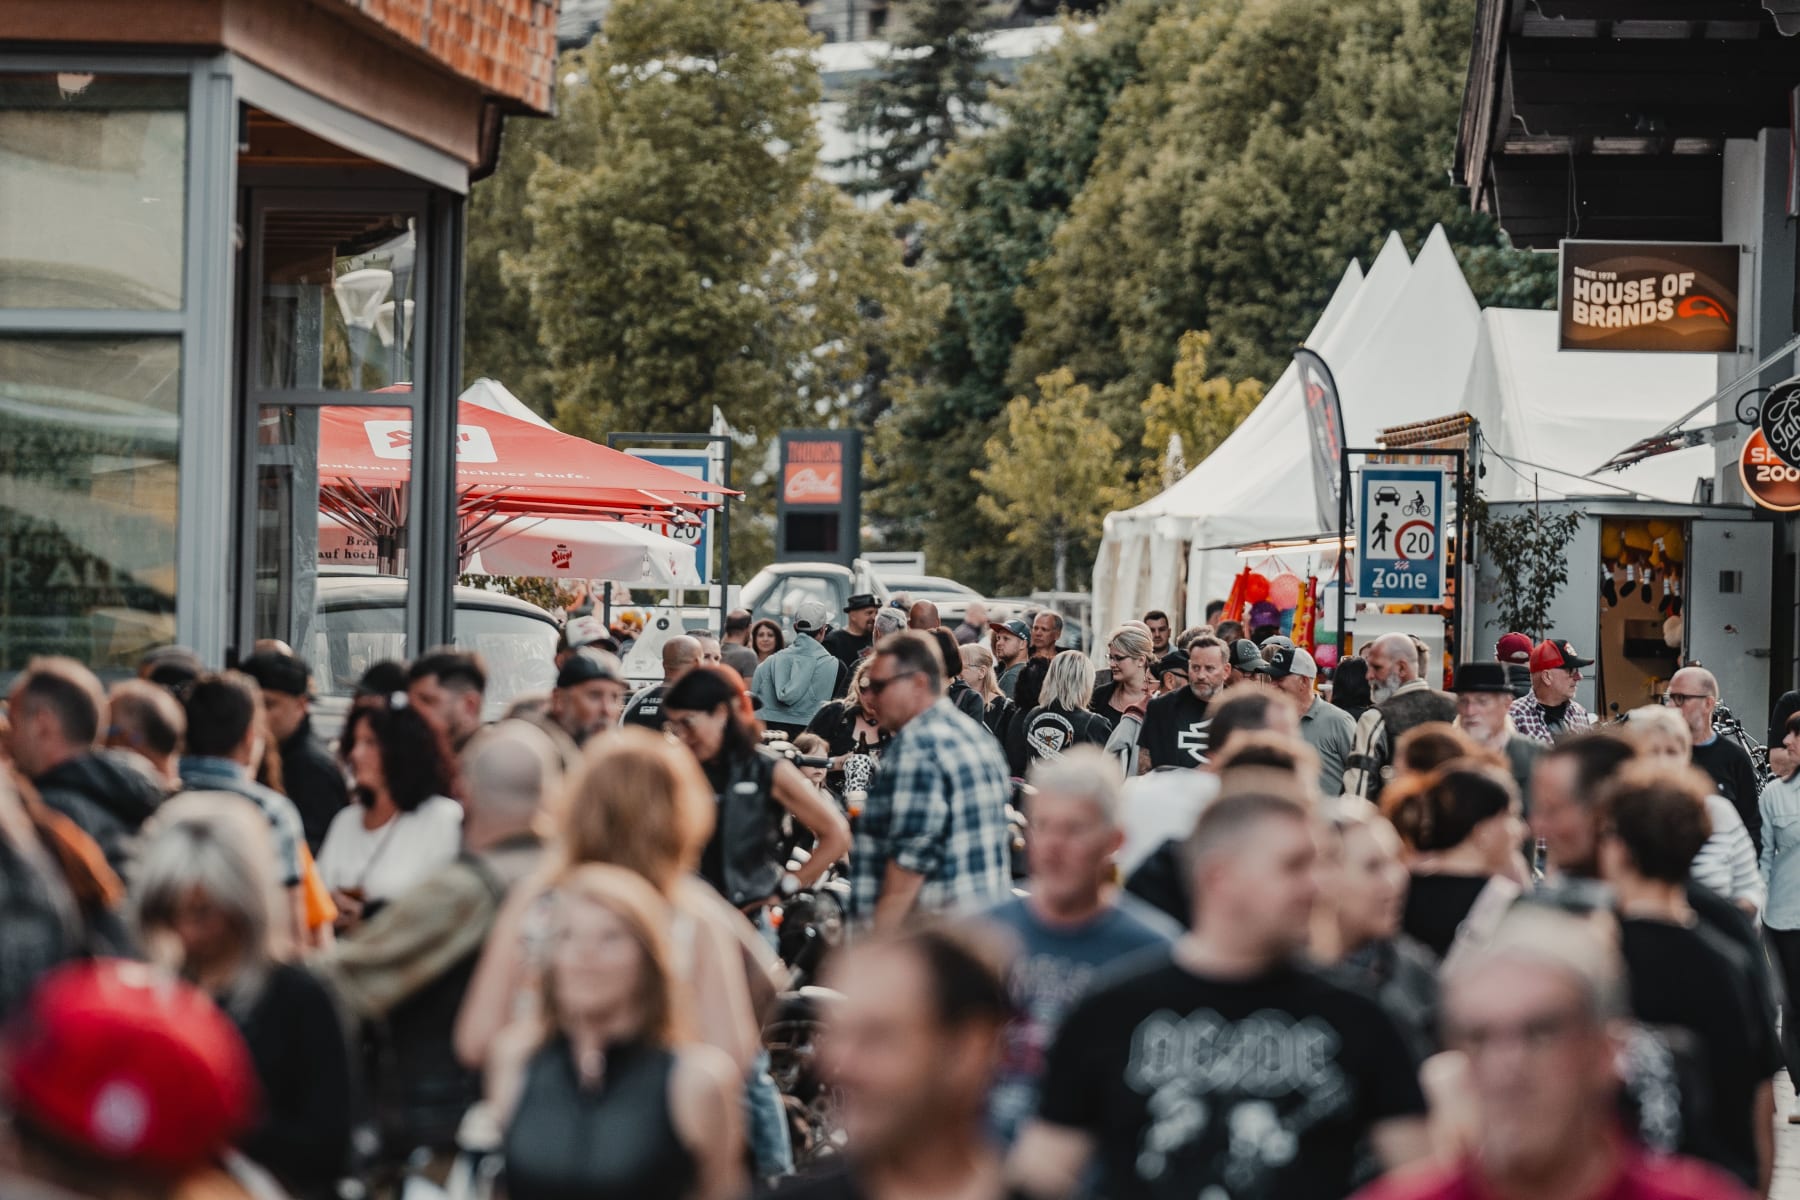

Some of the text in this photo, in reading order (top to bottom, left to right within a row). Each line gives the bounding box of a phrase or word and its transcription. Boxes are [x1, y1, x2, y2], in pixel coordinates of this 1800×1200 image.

[1573, 272, 1695, 305] HOUSE OF
[1572, 298, 1674, 328] BRANDS
[457, 468, 527, 478] öchster
[344, 548, 376, 559] höch
[1406, 532, 1430, 554] 20
[1372, 567, 1427, 590] Zone
